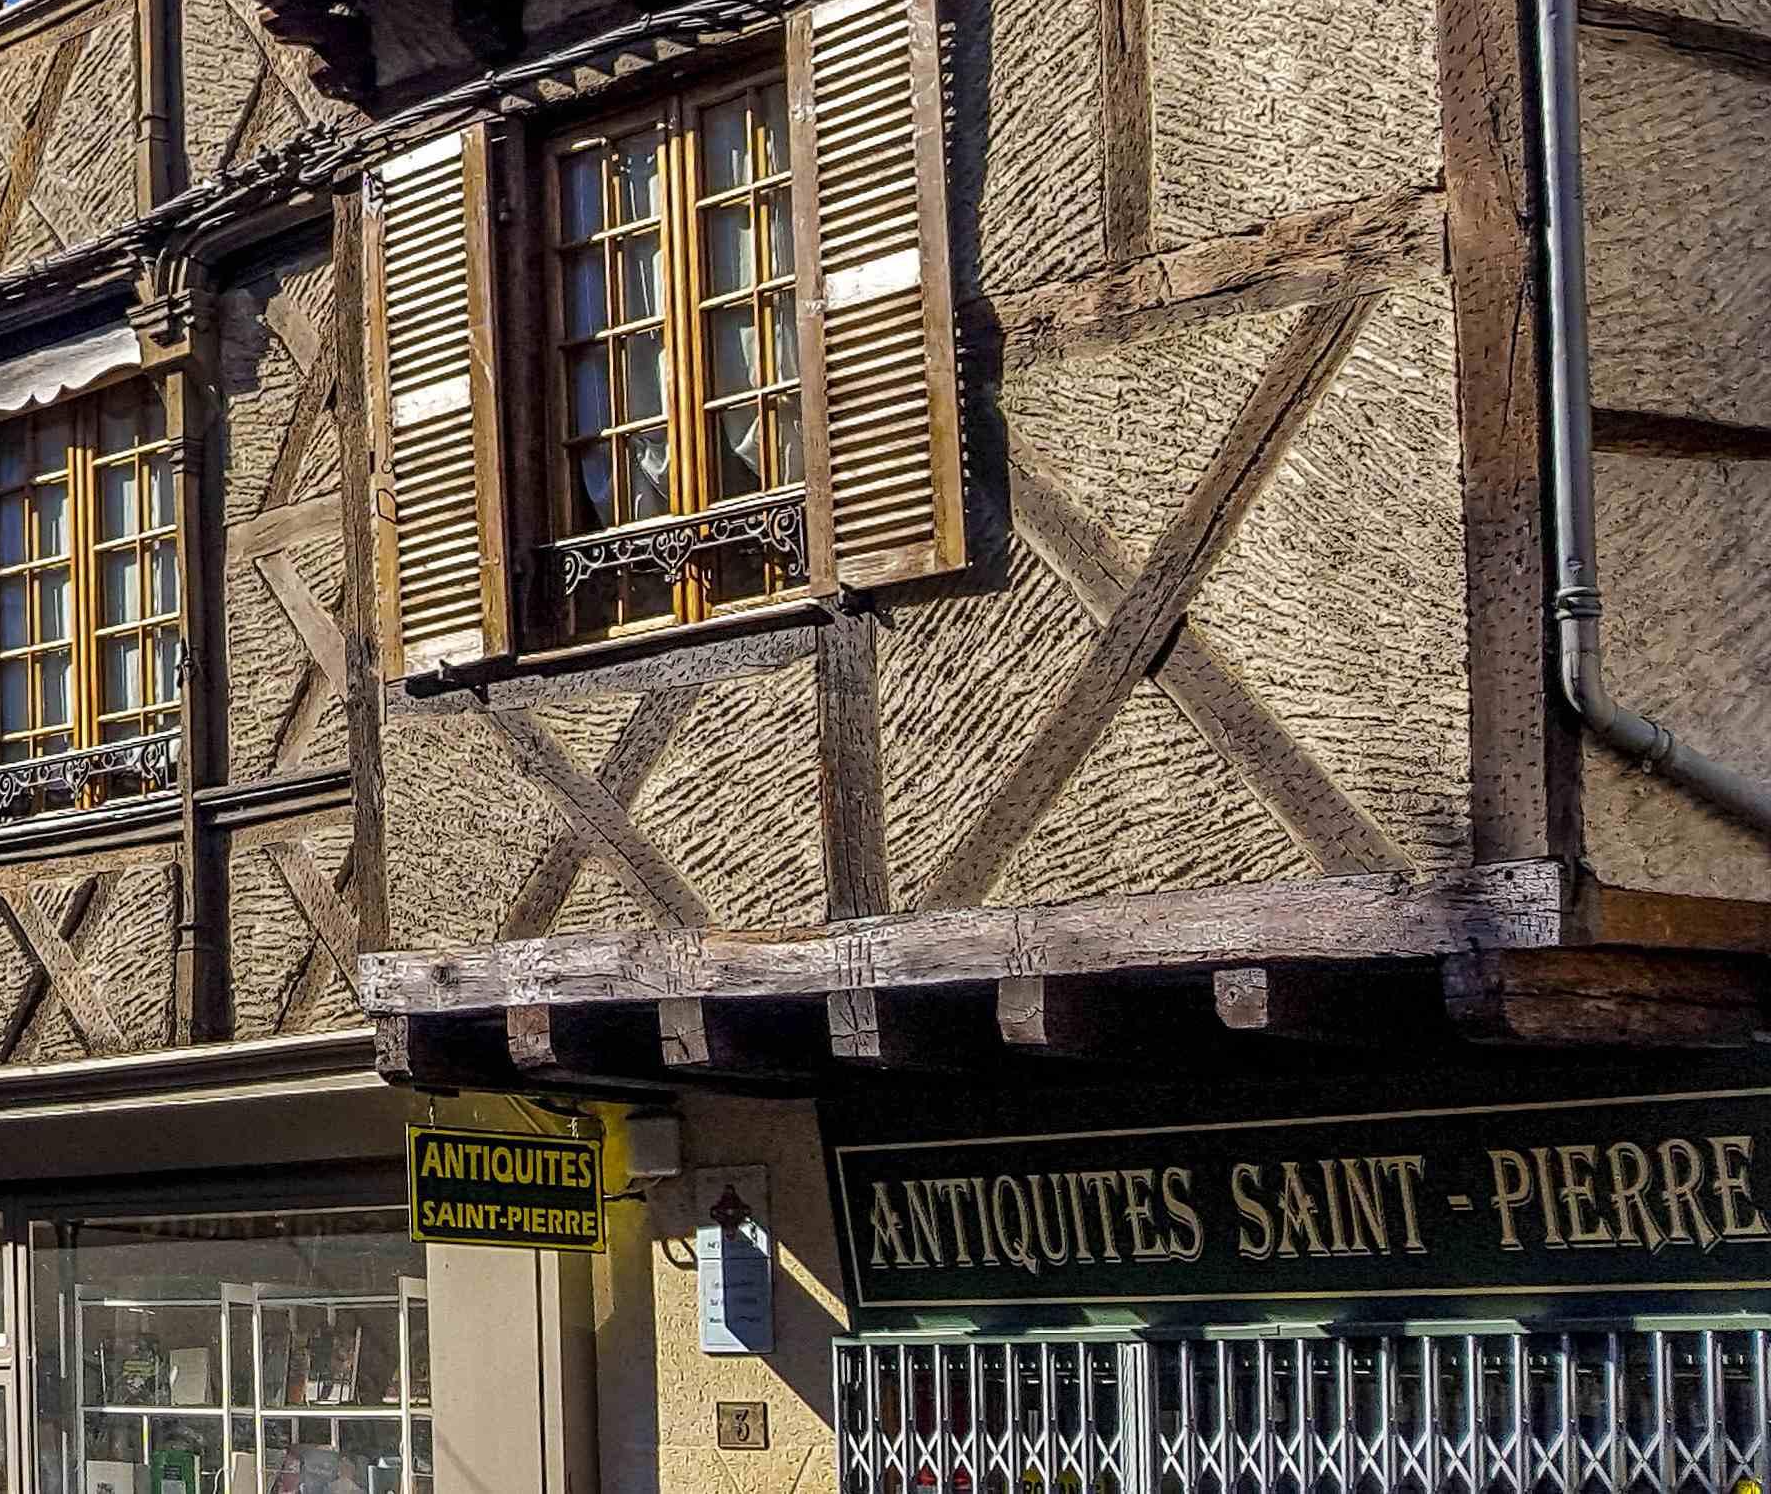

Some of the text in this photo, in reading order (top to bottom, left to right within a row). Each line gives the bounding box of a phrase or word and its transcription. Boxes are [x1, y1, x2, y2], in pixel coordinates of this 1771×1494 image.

[420, 1141, 592, 1188] ANTIQUITES
[422, 1200, 597, 1236] SAINT-PIERRE
[869, 1164, 1204, 1274] ANTIQUITES
[1231, 1153, 1428, 1263] SAINT
[1485, 1135, 1771, 1256] PIERRE
[734, 1409, 751, 1442] 3
